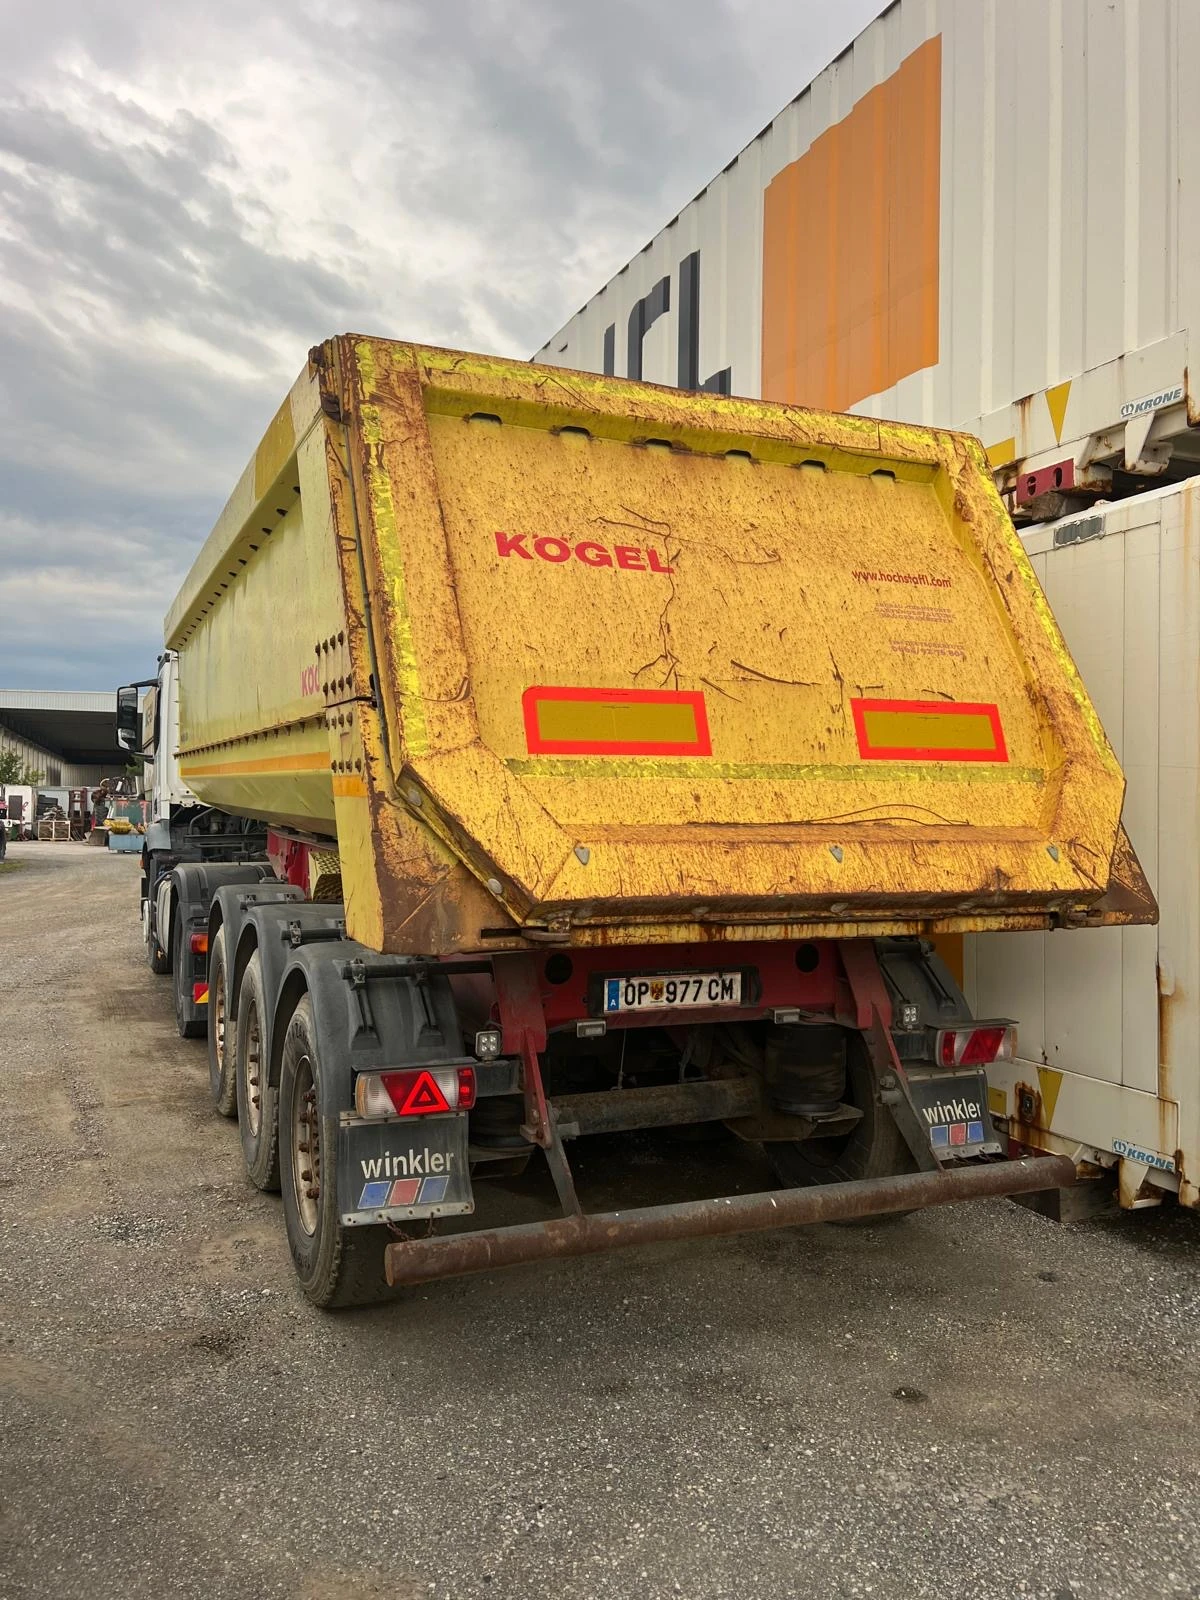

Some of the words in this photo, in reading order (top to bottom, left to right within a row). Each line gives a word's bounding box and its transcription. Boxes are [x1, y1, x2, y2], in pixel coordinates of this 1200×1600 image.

[1134, 388, 1183, 414] KRONE
[494, 531, 675, 574] KÖGEL
[624, 982, 650, 1006] OP
[665, 979, 703, 1003] 977
[708, 978, 734, 1001] CM
[922, 1097, 982, 1124] winkler
[360, 1147, 455, 1179] winkler
[1127, 1147, 1175, 1170] KRONE
